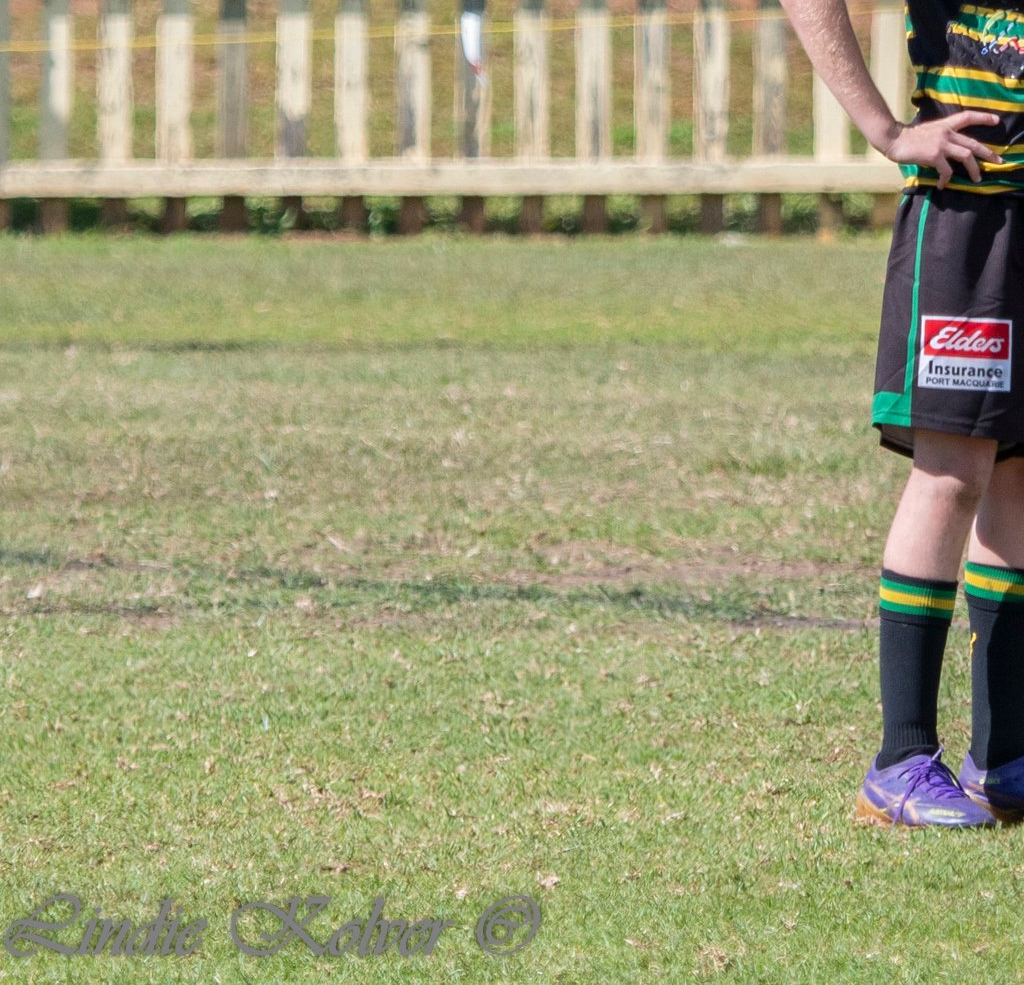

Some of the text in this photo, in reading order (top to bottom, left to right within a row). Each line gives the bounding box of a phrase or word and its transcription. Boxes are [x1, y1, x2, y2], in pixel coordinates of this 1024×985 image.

[929, 326, 1005, 353] Elders
[928, 359, 1003, 379] Insurance
[925, 376, 1005, 389] PORT MACQUARIE
